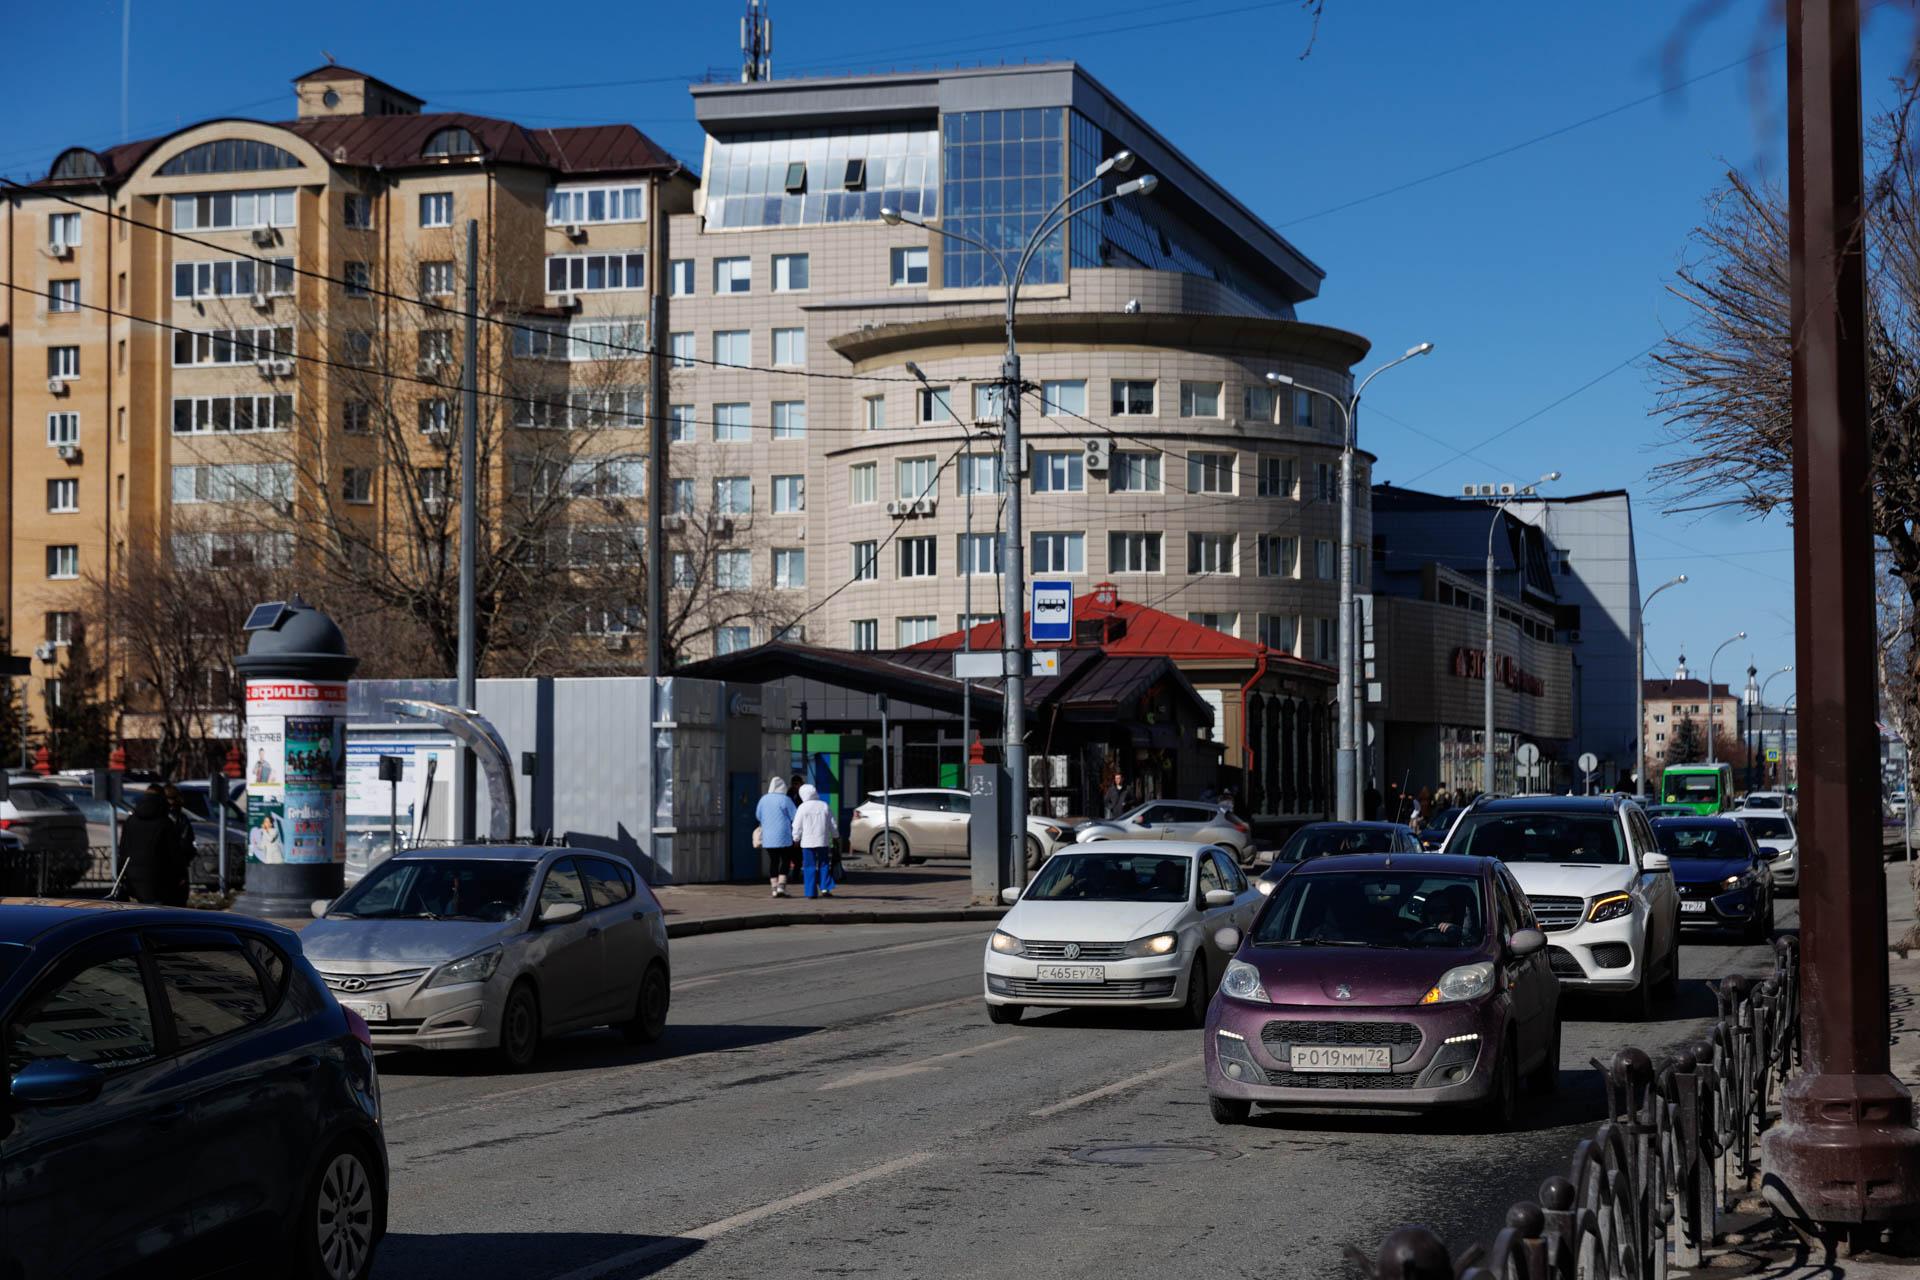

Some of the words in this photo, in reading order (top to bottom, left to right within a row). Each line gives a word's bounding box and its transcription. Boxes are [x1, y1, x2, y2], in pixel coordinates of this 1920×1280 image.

[251, 685, 319, 700] афиша
[1089, 967, 1101, 977] 72
[370, 1004, 384, 1016] 72
[1367, 1049, 1384, 1062] 72
